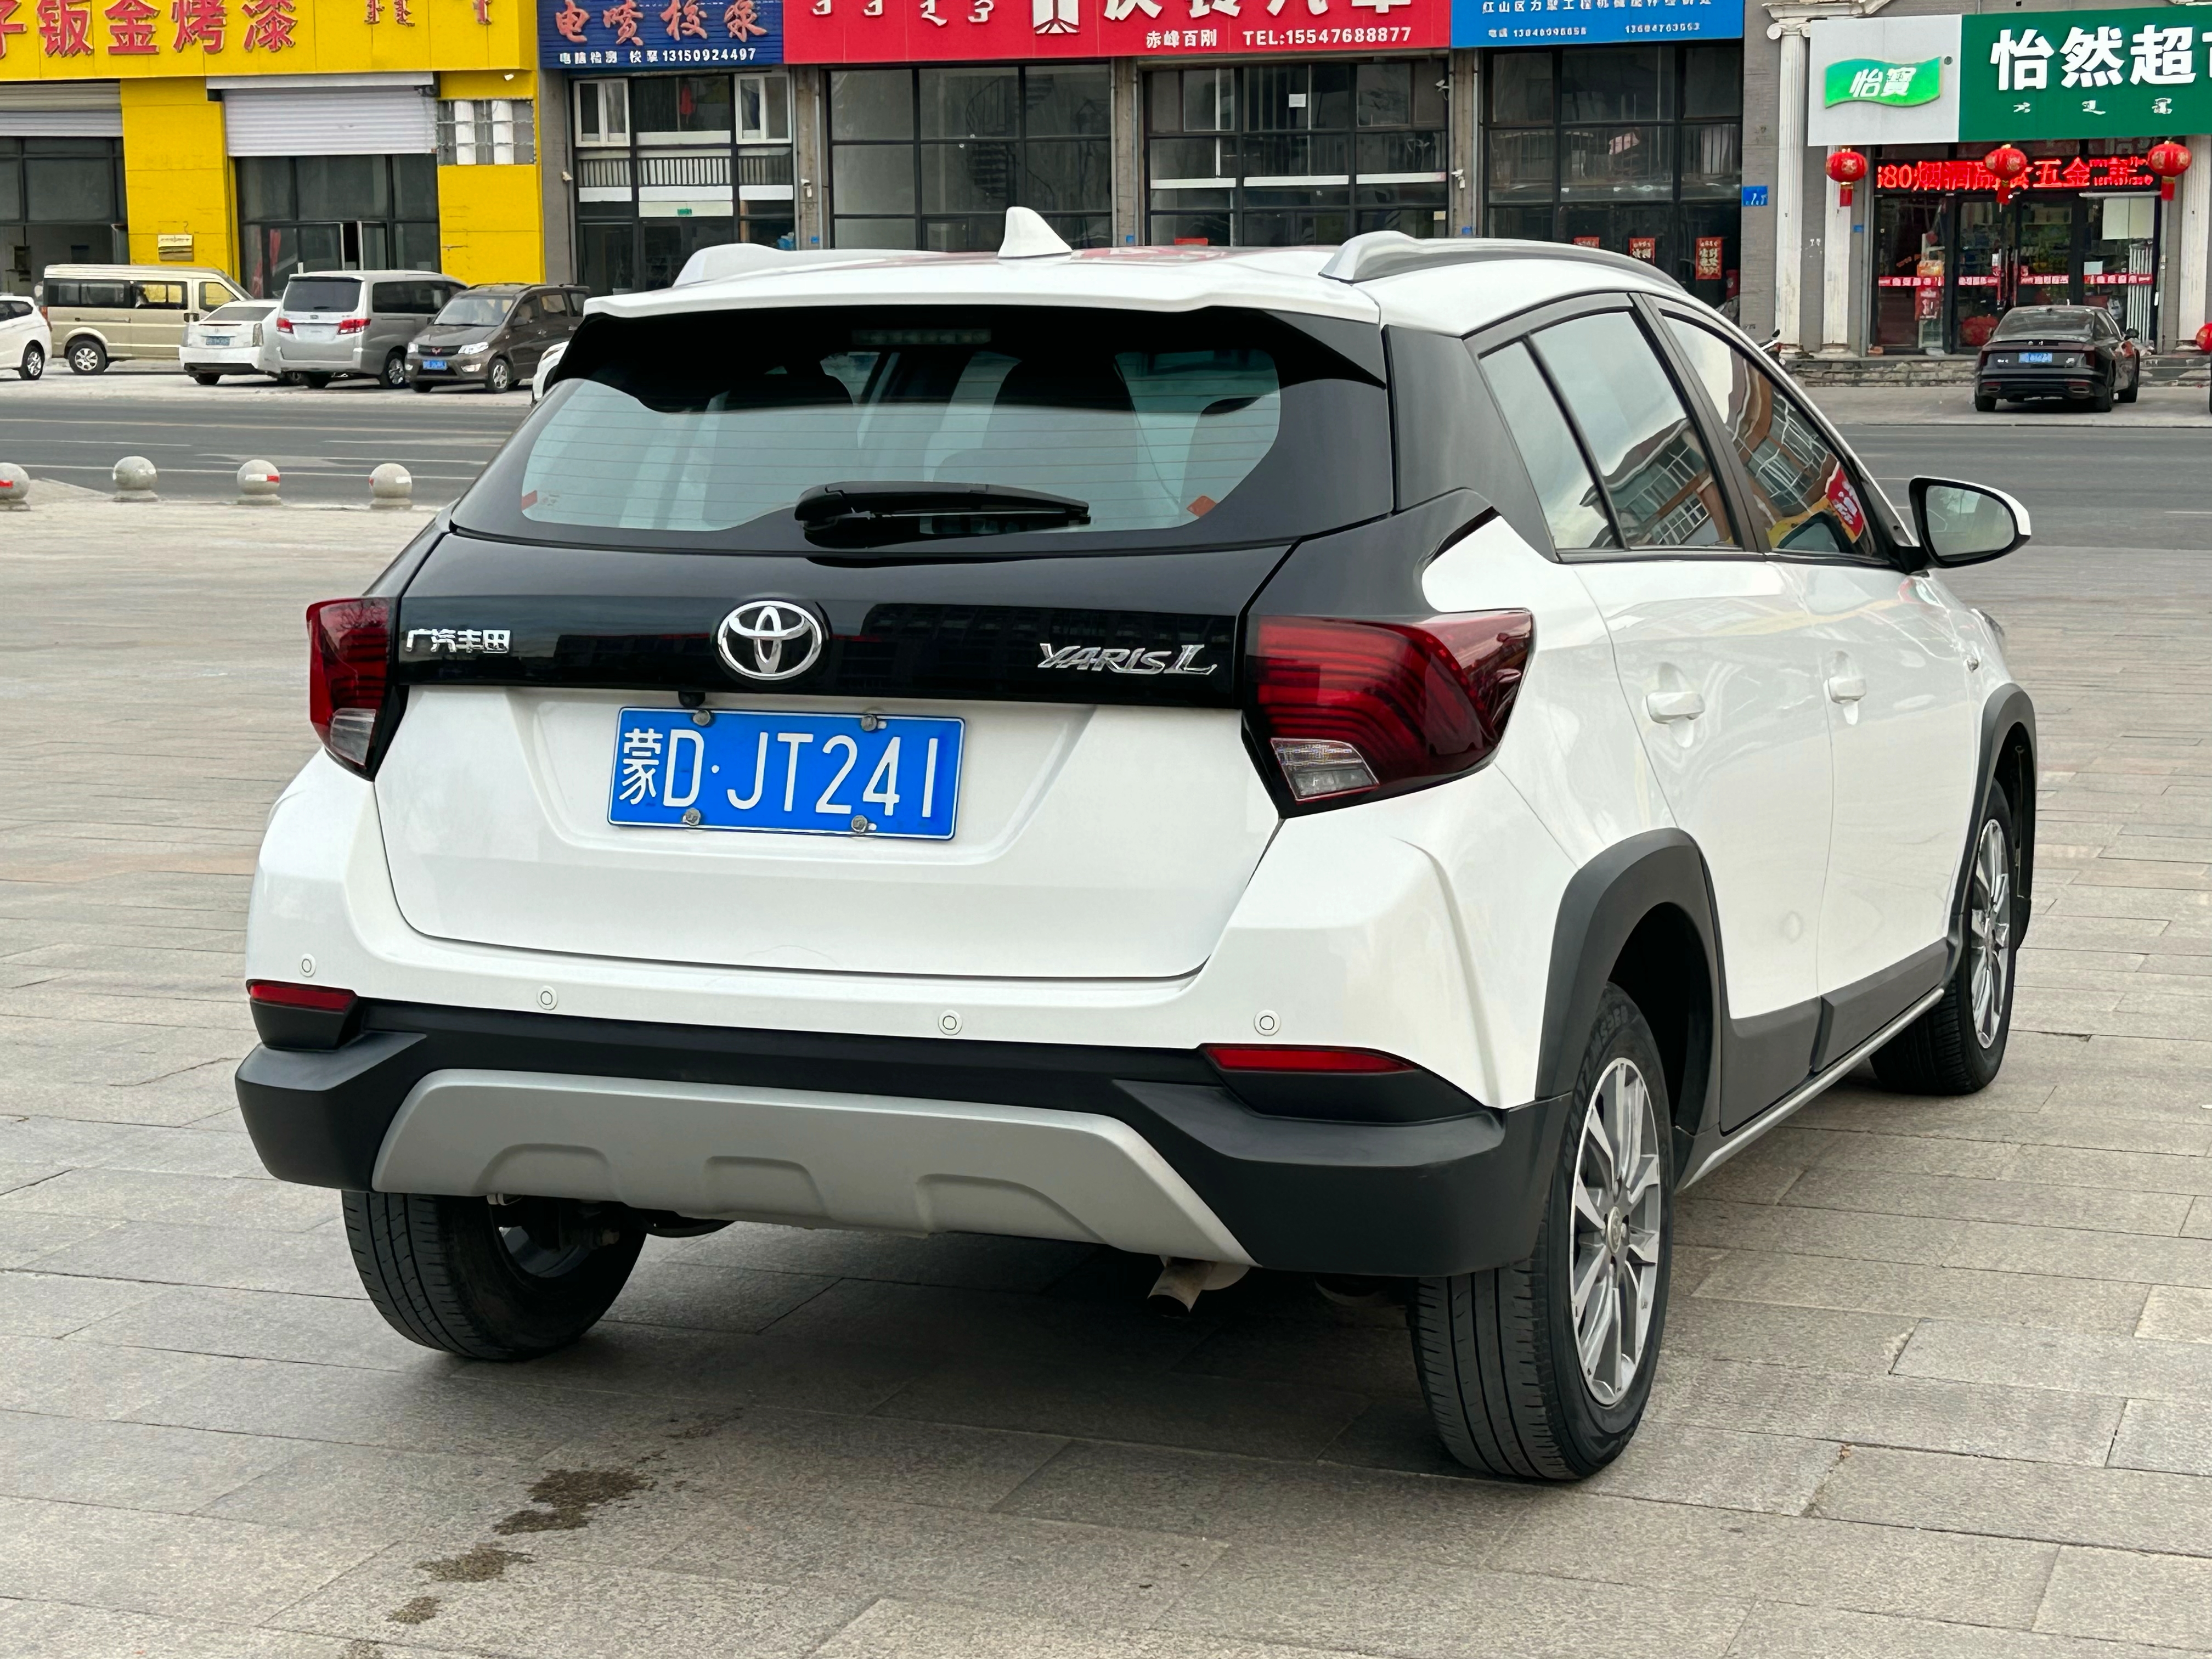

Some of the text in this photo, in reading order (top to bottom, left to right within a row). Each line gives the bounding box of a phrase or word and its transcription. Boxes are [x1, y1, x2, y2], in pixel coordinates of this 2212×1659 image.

[1146, 29, 1217, 49] 赤峰百刚
[1242, 26, 1412, 47] TEL:15547688877
[662, 48, 756, 62] 13150924497
[1990, 24, 2212, 91] 怡然超
[405, 628, 511, 653] 广汽丰田
[1037, 642, 1217, 675] YARIS L
